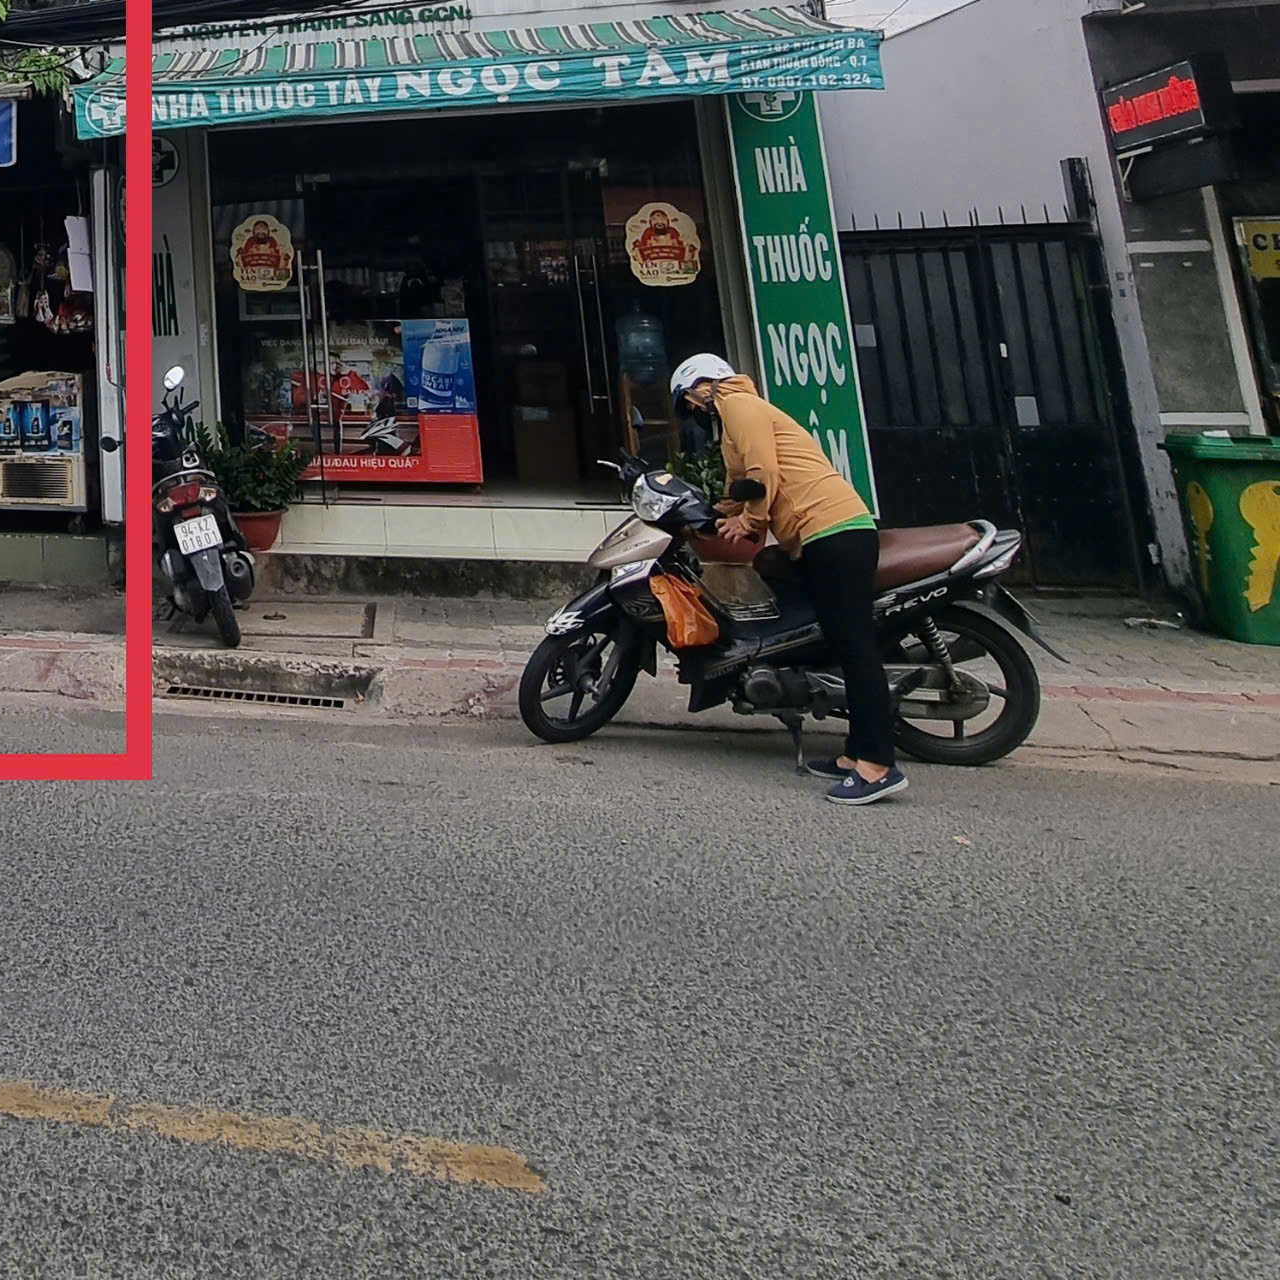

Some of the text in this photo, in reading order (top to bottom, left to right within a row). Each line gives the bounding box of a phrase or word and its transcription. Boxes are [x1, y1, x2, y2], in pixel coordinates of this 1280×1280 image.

[354, 7, 414, 27] SANG
[848, 38, 865, 48] BA
[324, 74, 382, 106] TÂY
[395, 62, 561, 103] NGỌC
[593, 46, 729, 87] TÂM
[850, 55, 867, 67] Q.7
[755, 136, 807, 193] NHÀ
[752, 216, 832, 282] THUỐC
[768, 322, 846, 405] NGỌC
